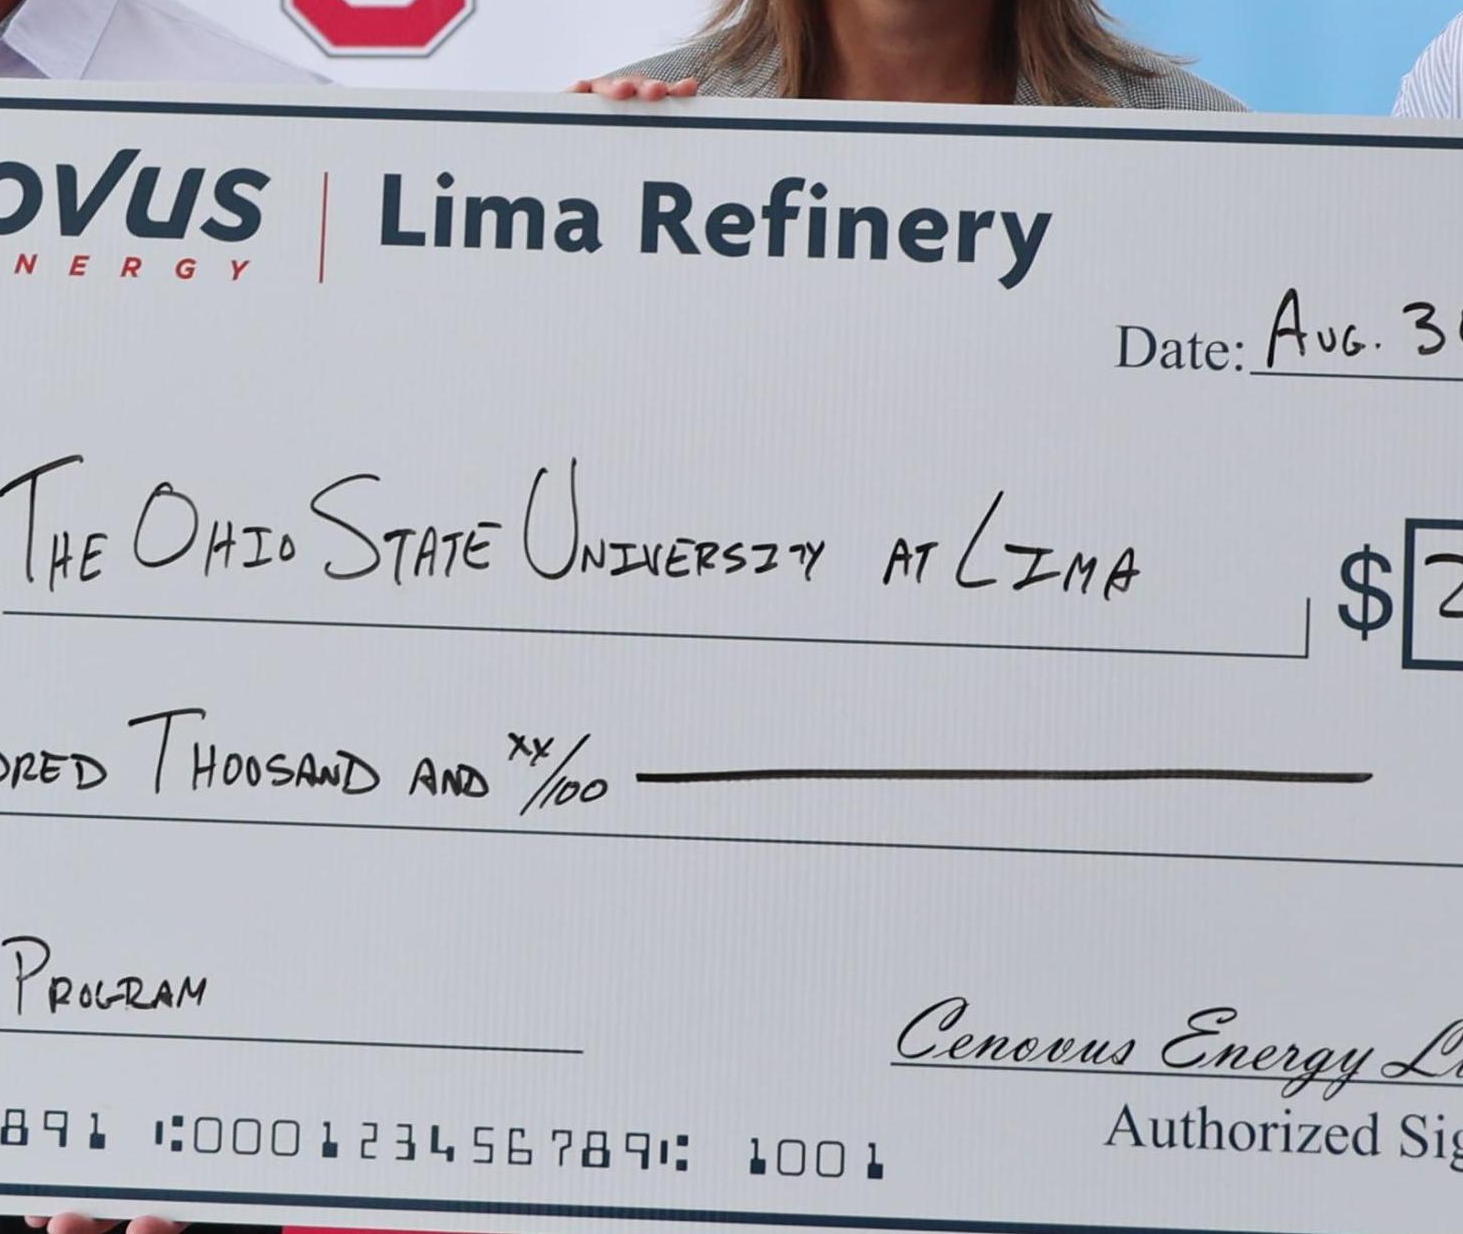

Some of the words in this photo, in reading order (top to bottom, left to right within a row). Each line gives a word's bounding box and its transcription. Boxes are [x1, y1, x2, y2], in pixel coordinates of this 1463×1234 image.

[381, 172, 602, 253] Lima
[641, 177, 1052, 289] Refinery
[1118, 326, 1243, 371] Date:
[1338, 544, 1393, 641] $
[896, 996, 1136, 1065] Cenovus
[1161, 1006, 1375, 1101] Energy
[750, 1138, 883, 1179] 1001
[1105, 1101, 1379, 1157] Authorized
